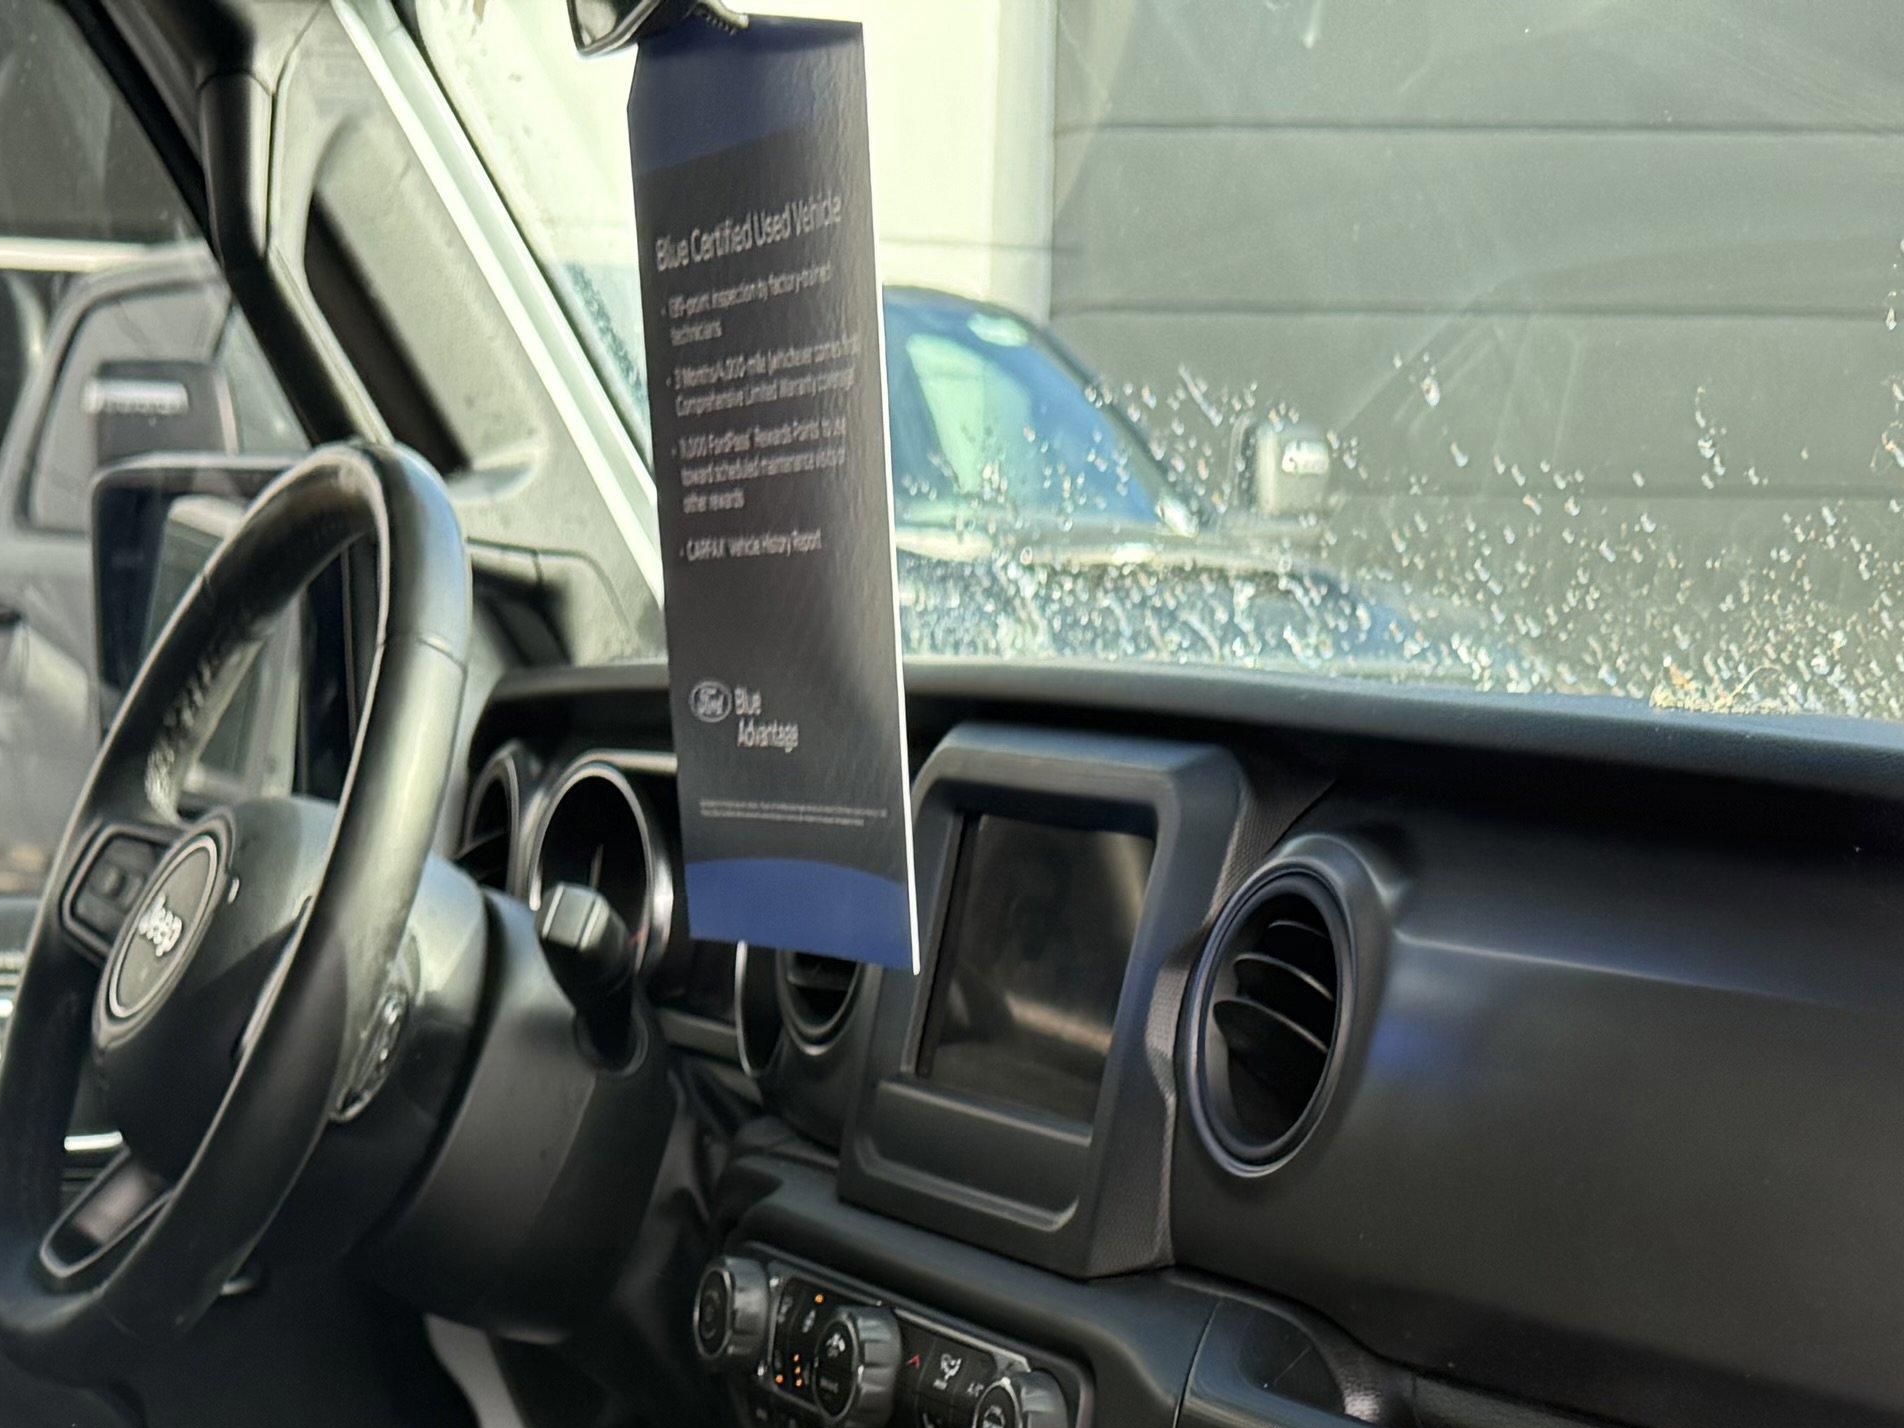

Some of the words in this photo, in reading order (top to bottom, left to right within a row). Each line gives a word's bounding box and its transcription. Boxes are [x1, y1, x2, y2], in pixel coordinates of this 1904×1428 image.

[656, 235, 689, 271] Blue
[690, 213, 752, 262] Certified
[753, 203, 791, 247] Used
[792, 191, 842, 237] Vehicle
[734, 686, 763, 717] Blue
[736, 716, 799, 754] Advantage
